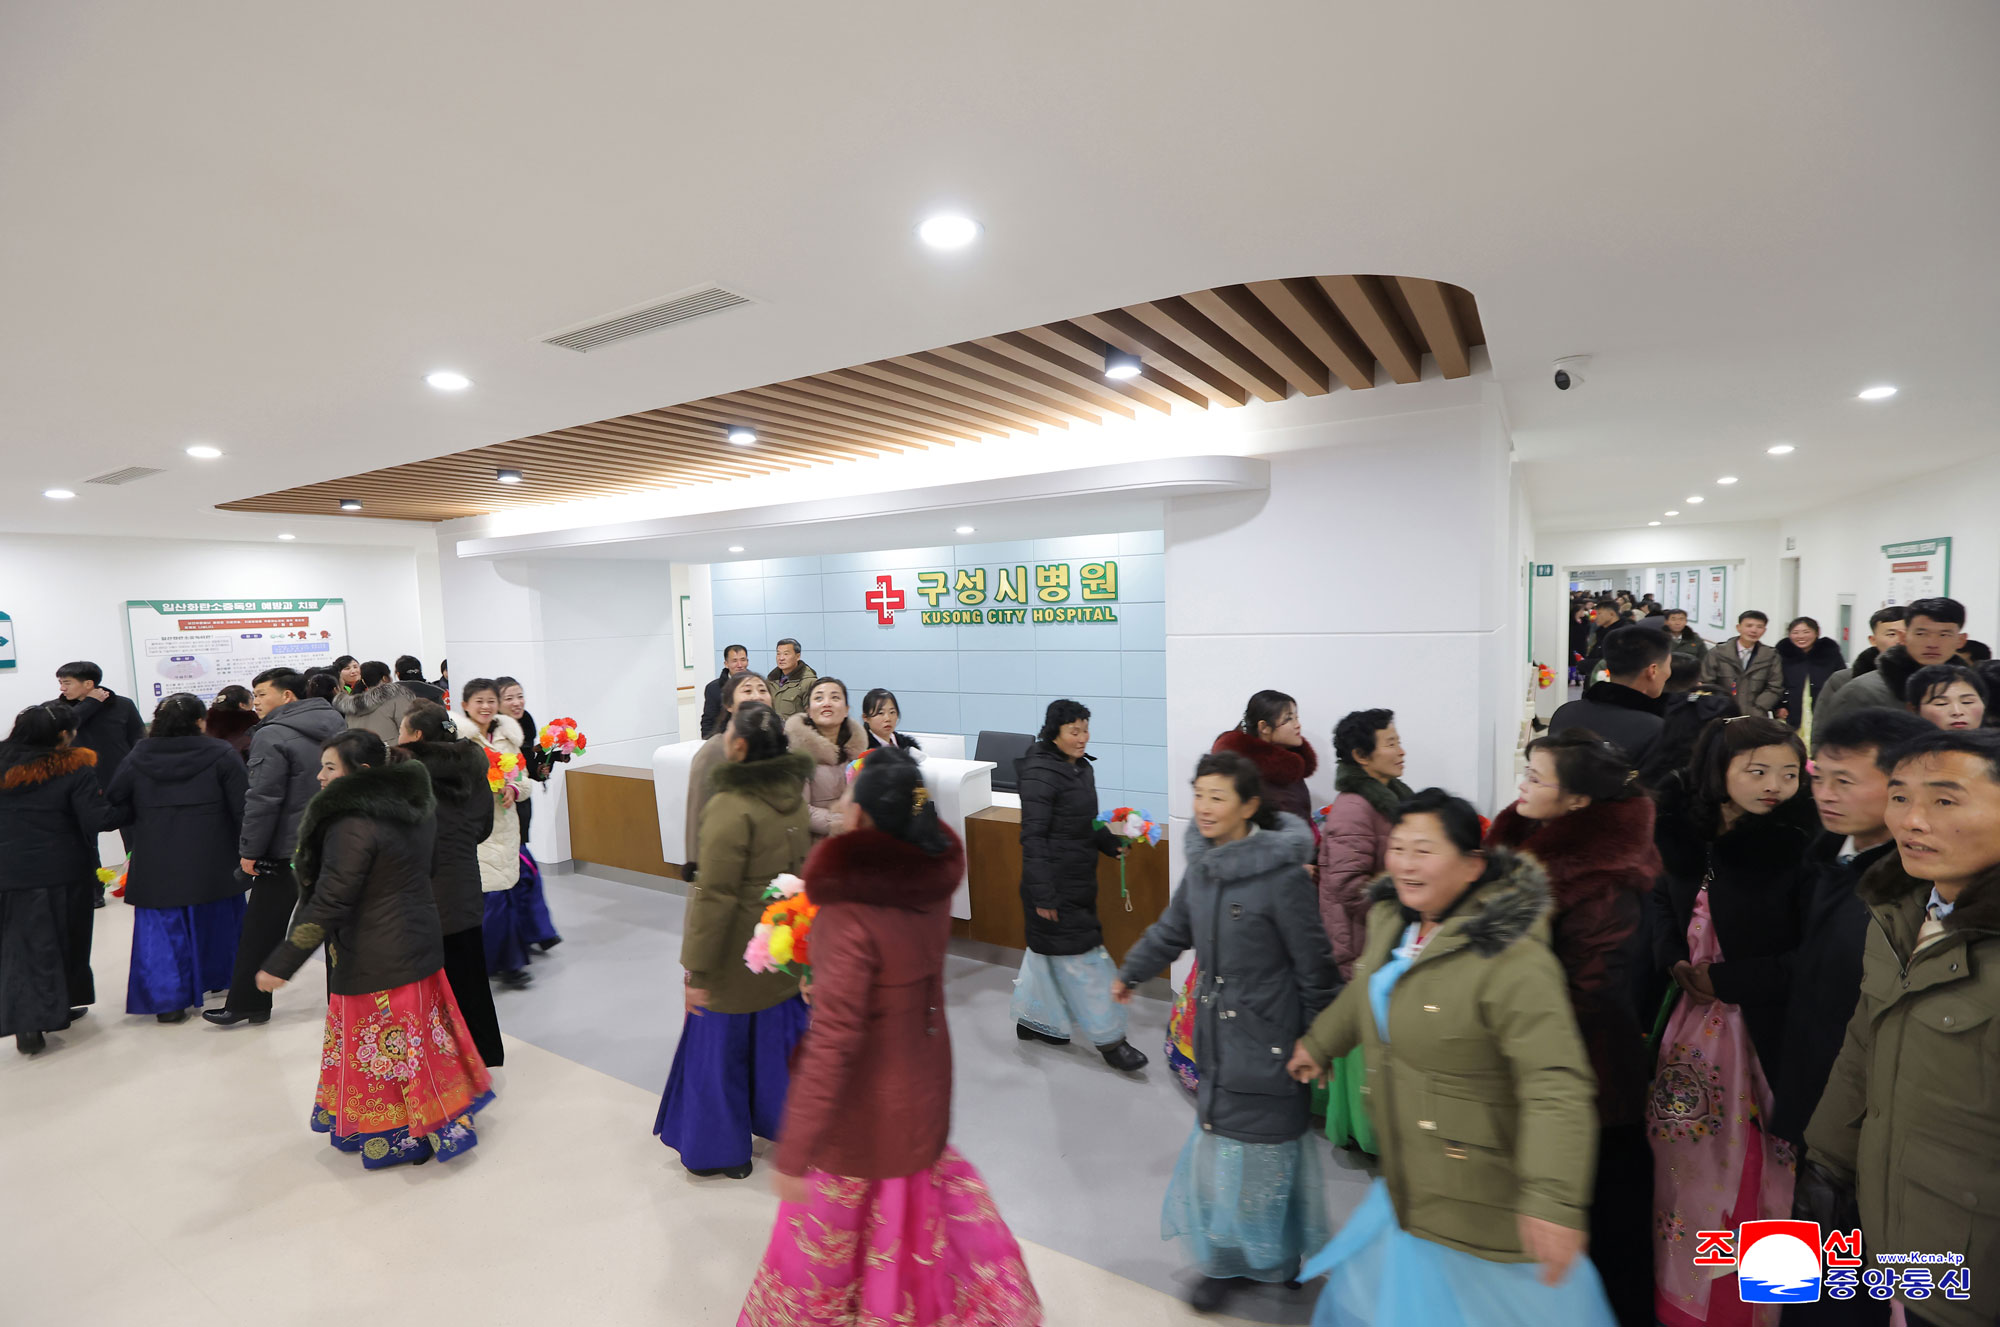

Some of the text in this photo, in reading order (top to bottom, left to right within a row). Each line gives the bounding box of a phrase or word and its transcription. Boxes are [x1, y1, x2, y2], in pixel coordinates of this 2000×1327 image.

[162, 601, 319, 612] 일산화탄소중독의 예방과 치료
[921, 605, 1118, 626] KUSONG CITY HOSPITAL
